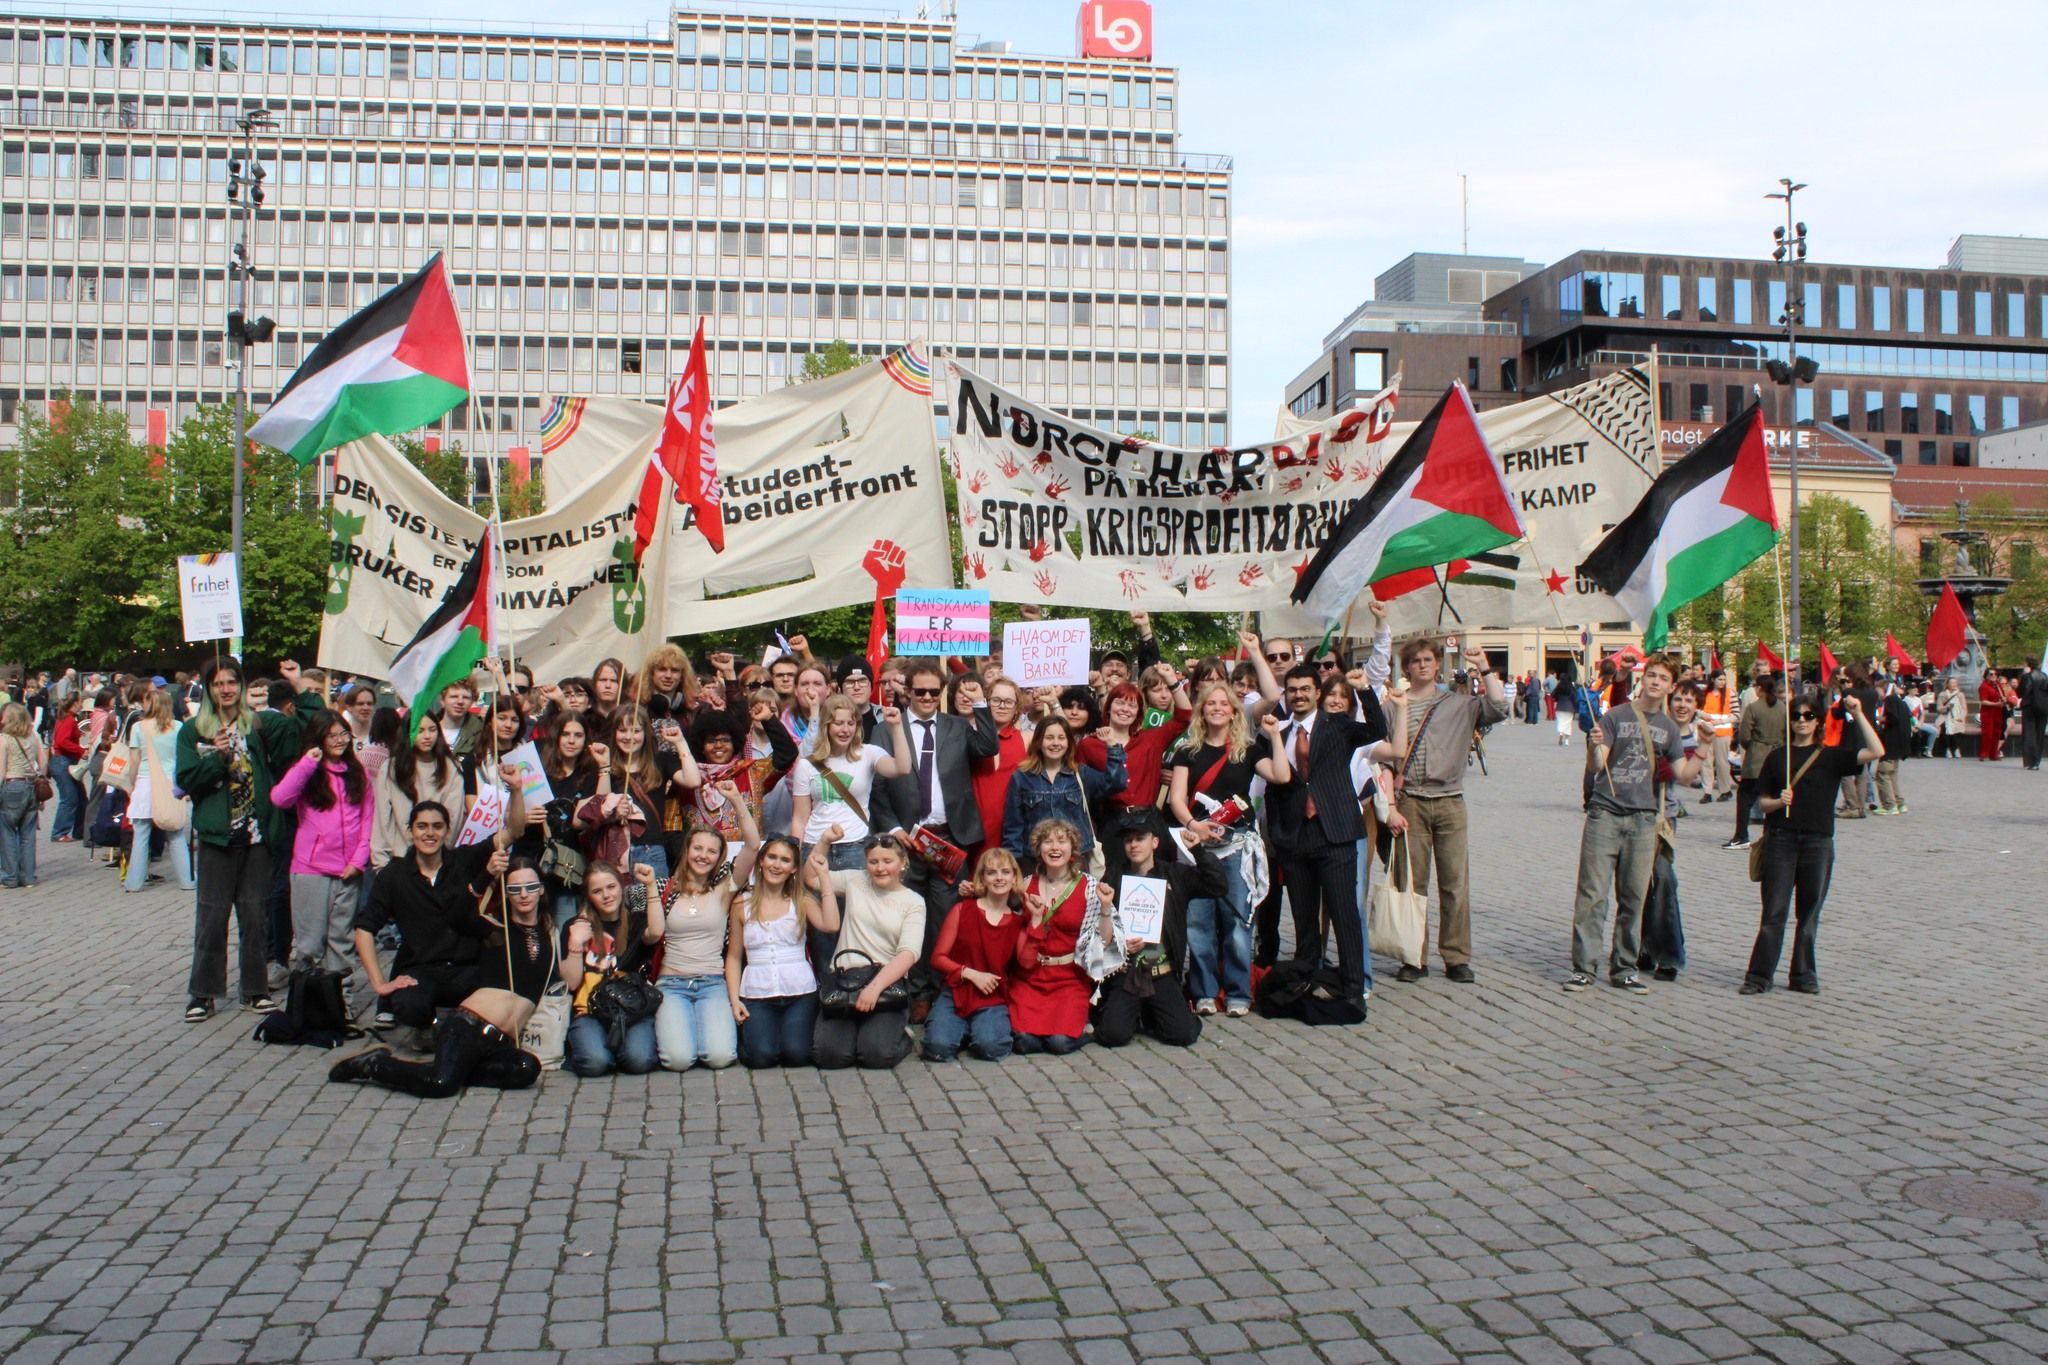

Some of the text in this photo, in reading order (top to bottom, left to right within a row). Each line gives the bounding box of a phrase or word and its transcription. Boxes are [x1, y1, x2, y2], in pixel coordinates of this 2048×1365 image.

[1095, 5, 1142, 52] LO
[1503, 441, 1589, 475] FRIHET
[718, 454, 852, 499] tudent-
[682, 465, 917, 531] Abeiderfront
[1521, 483, 1596, 511] KAMP
[335, 474, 381, 510] DEN
[385, 504, 458, 547] SISTE
[979, 499, 1068, 552] STOPP
[331, 540, 435, 599] BRUKER
[433, 554, 456, 571] ER
[191, 575, 230, 593] frihet
[903, 596, 981, 612] TRANSKAMP
[929, 616, 952, 630] ER
[898, 632, 987, 653] KLASSEKAMP
[1063, 629, 1086, 643] DET
[1022, 646, 1069, 660] ER DITT
[1024, 659, 1068, 679] BARN?
